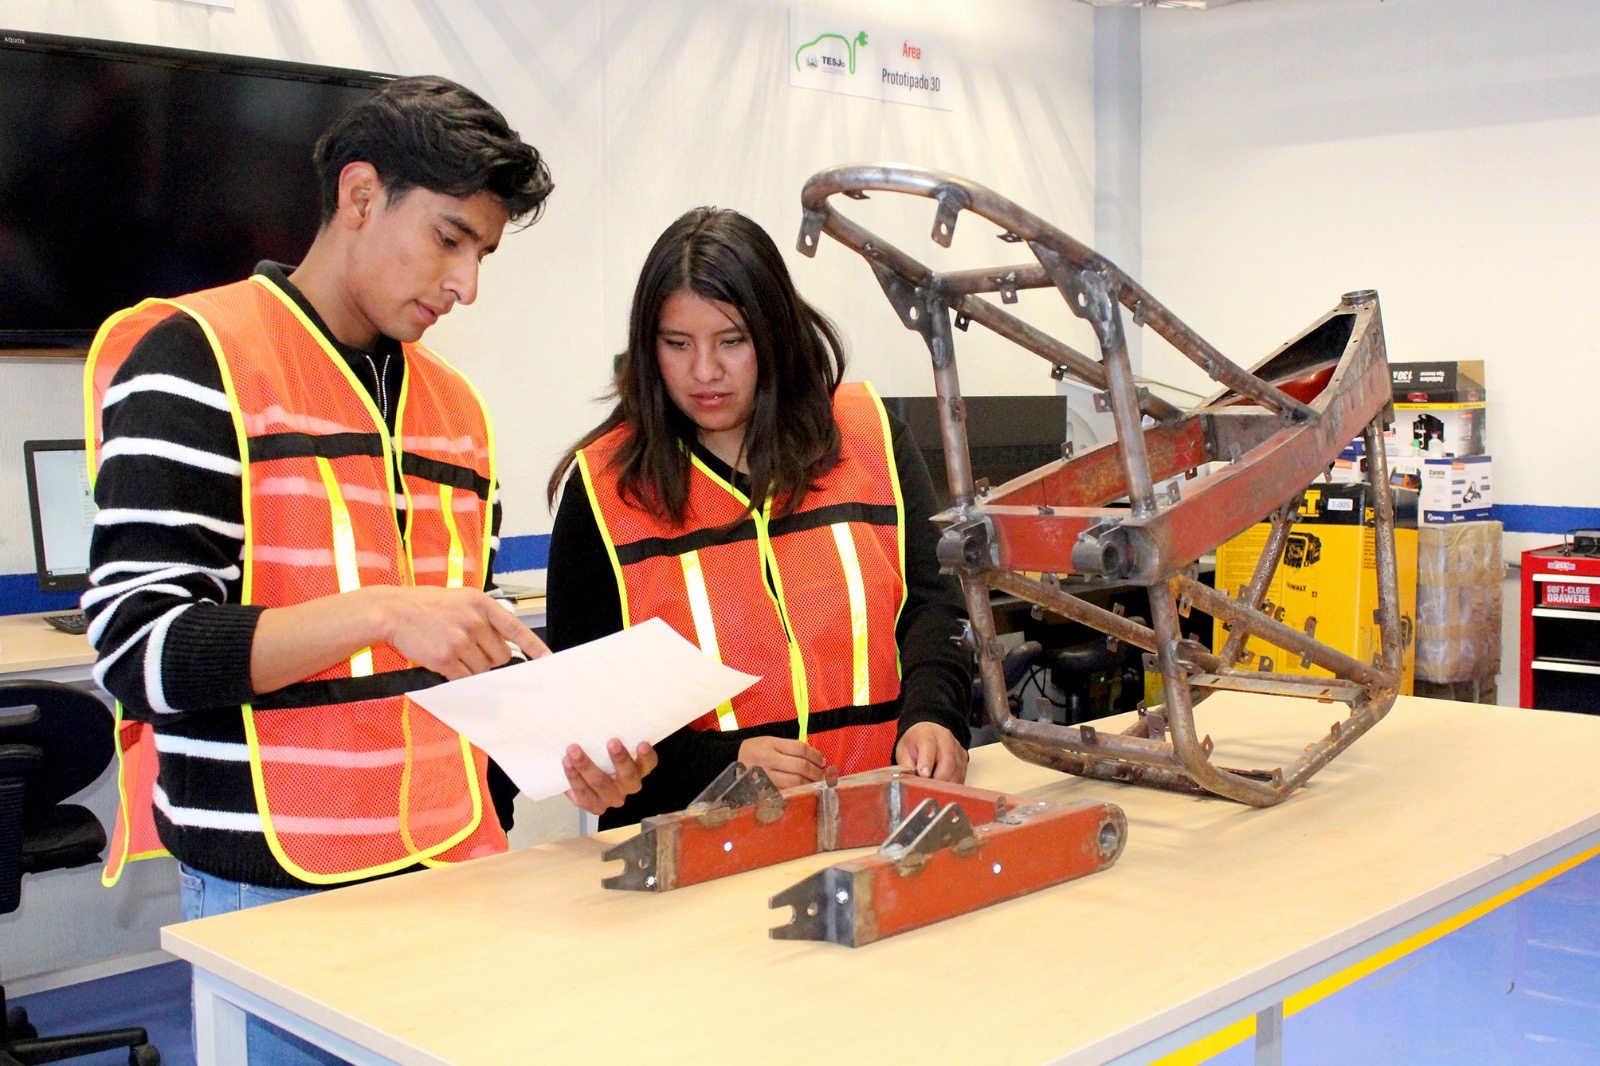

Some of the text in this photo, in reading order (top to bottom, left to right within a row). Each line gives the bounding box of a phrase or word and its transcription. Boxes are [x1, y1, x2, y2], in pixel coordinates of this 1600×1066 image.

[902, 40, 921, 60] Área
[882, 68, 941, 92] Prototipado 3D
[1331, 500, 1350, 508] T-005
[1547, 585, 1590, 595] SOFT-CLOSE
[1547, 594, 1591, 604] DRAWERS
